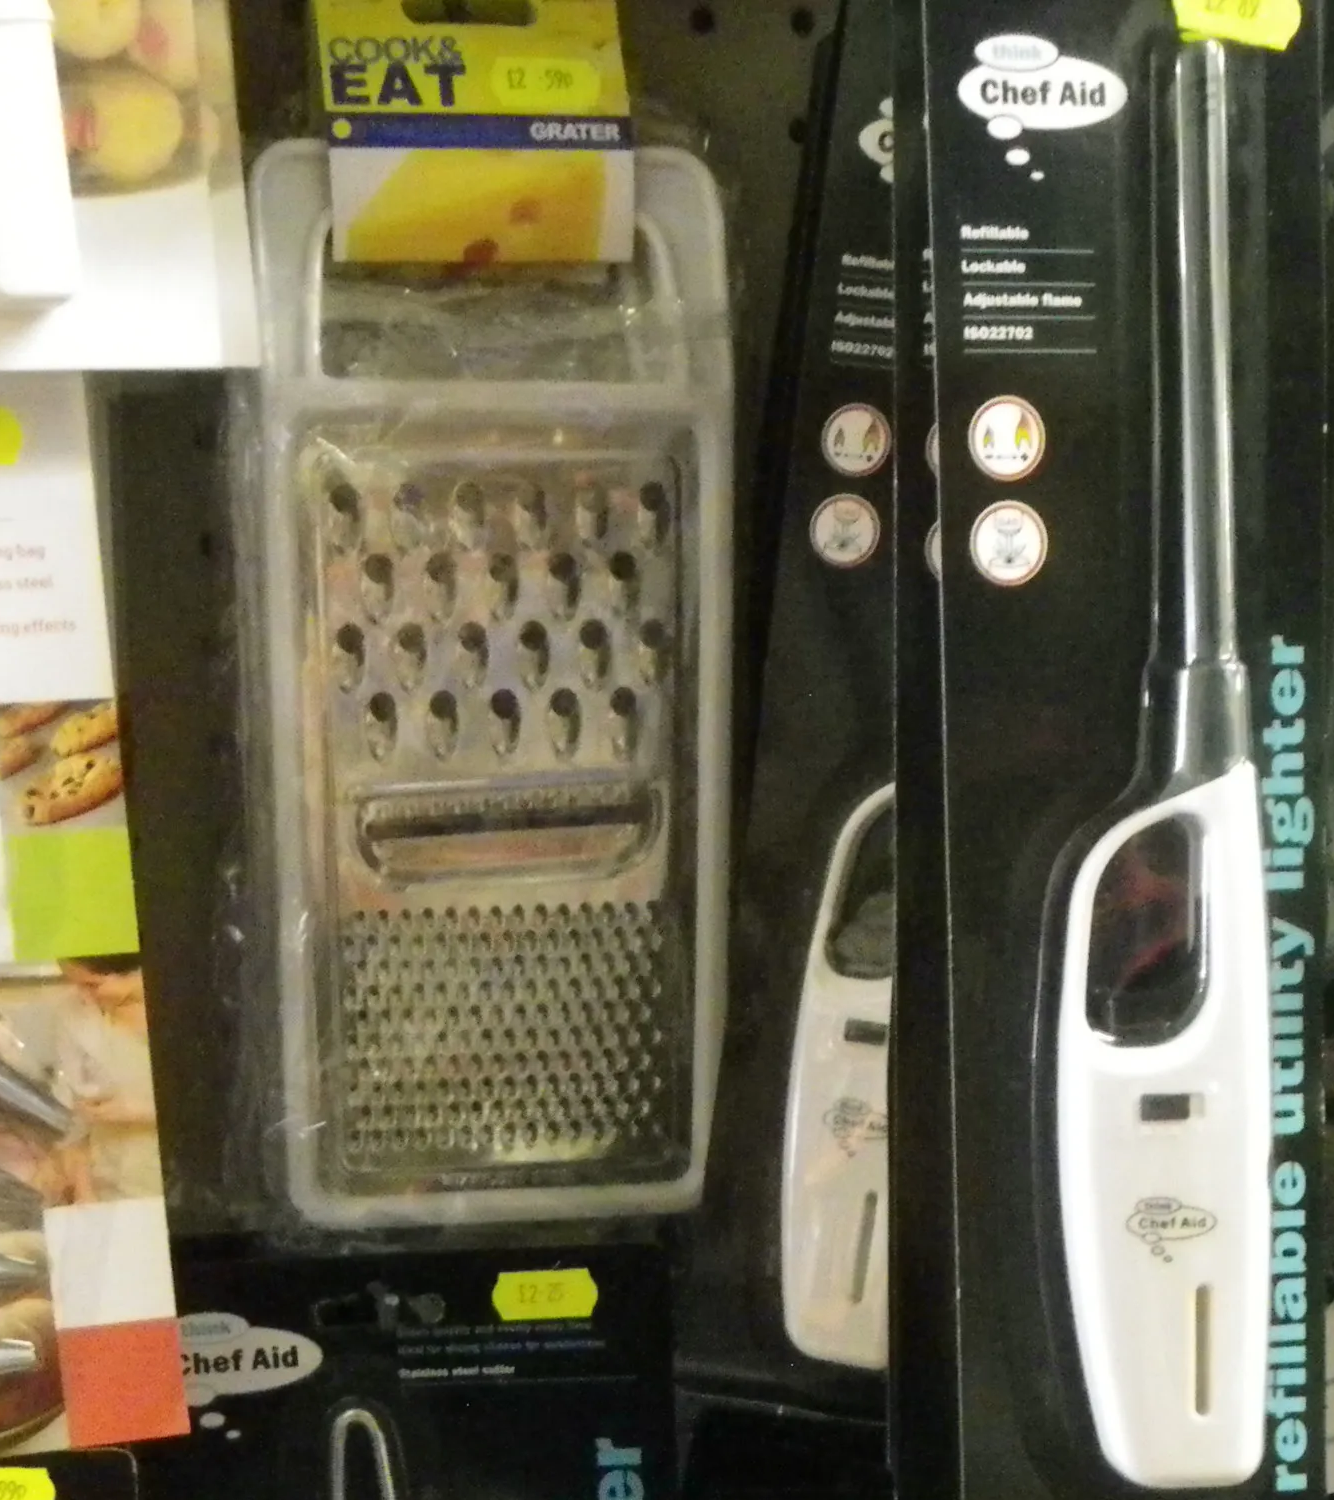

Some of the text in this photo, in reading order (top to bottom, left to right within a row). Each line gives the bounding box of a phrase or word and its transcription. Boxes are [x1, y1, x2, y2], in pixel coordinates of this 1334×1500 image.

[330, 62, 466, 107] EAT
[979, 79, 1106, 107] Chef Aid
[529, 121, 621, 142] GRATER
[960, 225, 1030, 240] Refillable
[961, 259, 1027, 274] Lockable
[963, 292, 1039, 309] Adjustable
[16, 543, 45, 561] bag
[1263, 634, 1315, 1493] refillable utility lighter
[1138, 1216, 1207, 1229] Chef Aid
[251, 1346, 300, 1370] Aid
